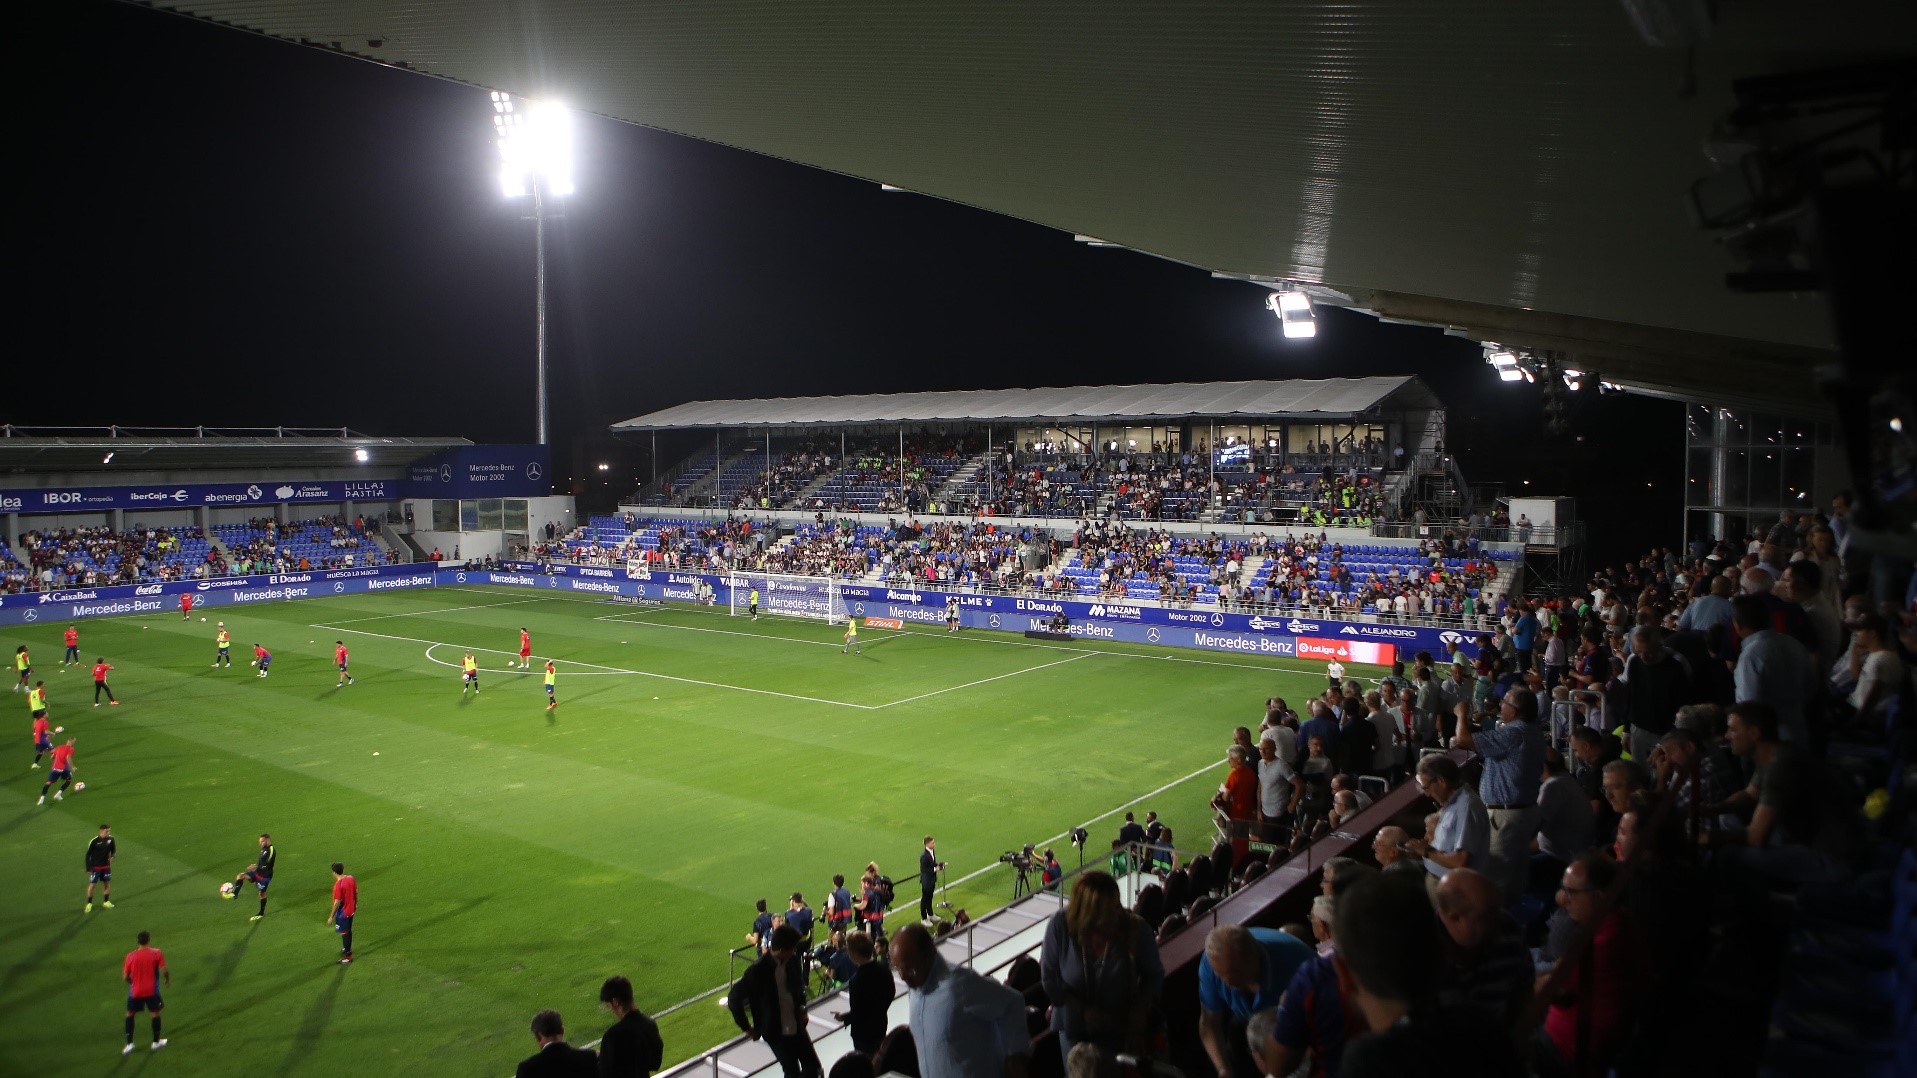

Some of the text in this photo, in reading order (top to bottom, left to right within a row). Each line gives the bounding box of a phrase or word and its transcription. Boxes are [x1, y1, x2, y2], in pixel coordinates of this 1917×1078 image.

[345, 482, 384, 491] LILLAS
[44, 492, 82, 504] IBOR
[345, 489, 384, 498] PASTIA
[369, 575, 432, 590] Mercedes-Benz
[490, 573, 534, 585] Mercedes-Benz
[135, 584, 163, 595] Coca-Cola
[572, 579, 619, 592] Mercedes-Benz
[53, 591, 97, 601] CaixaBank
[234, 587, 308, 602] Mercedes-Benz
[886, 589, 921, 602] Alcampo
[73, 600, 161, 617] Mercedes-Benz
[768, 596, 829, 611] Mercedes-Benz
[1107, 606, 1140, 615] MAZANA
[867, 619, 895, 627] STIHL
[1168, 613, 1207, 622] Motor 2002
[1360, 627, 1416, 637] ALEJANDRO
[1195, 633, 1293, 653] Mercedes-Benz
[1309, 645, 1335, 654] LaLiga
